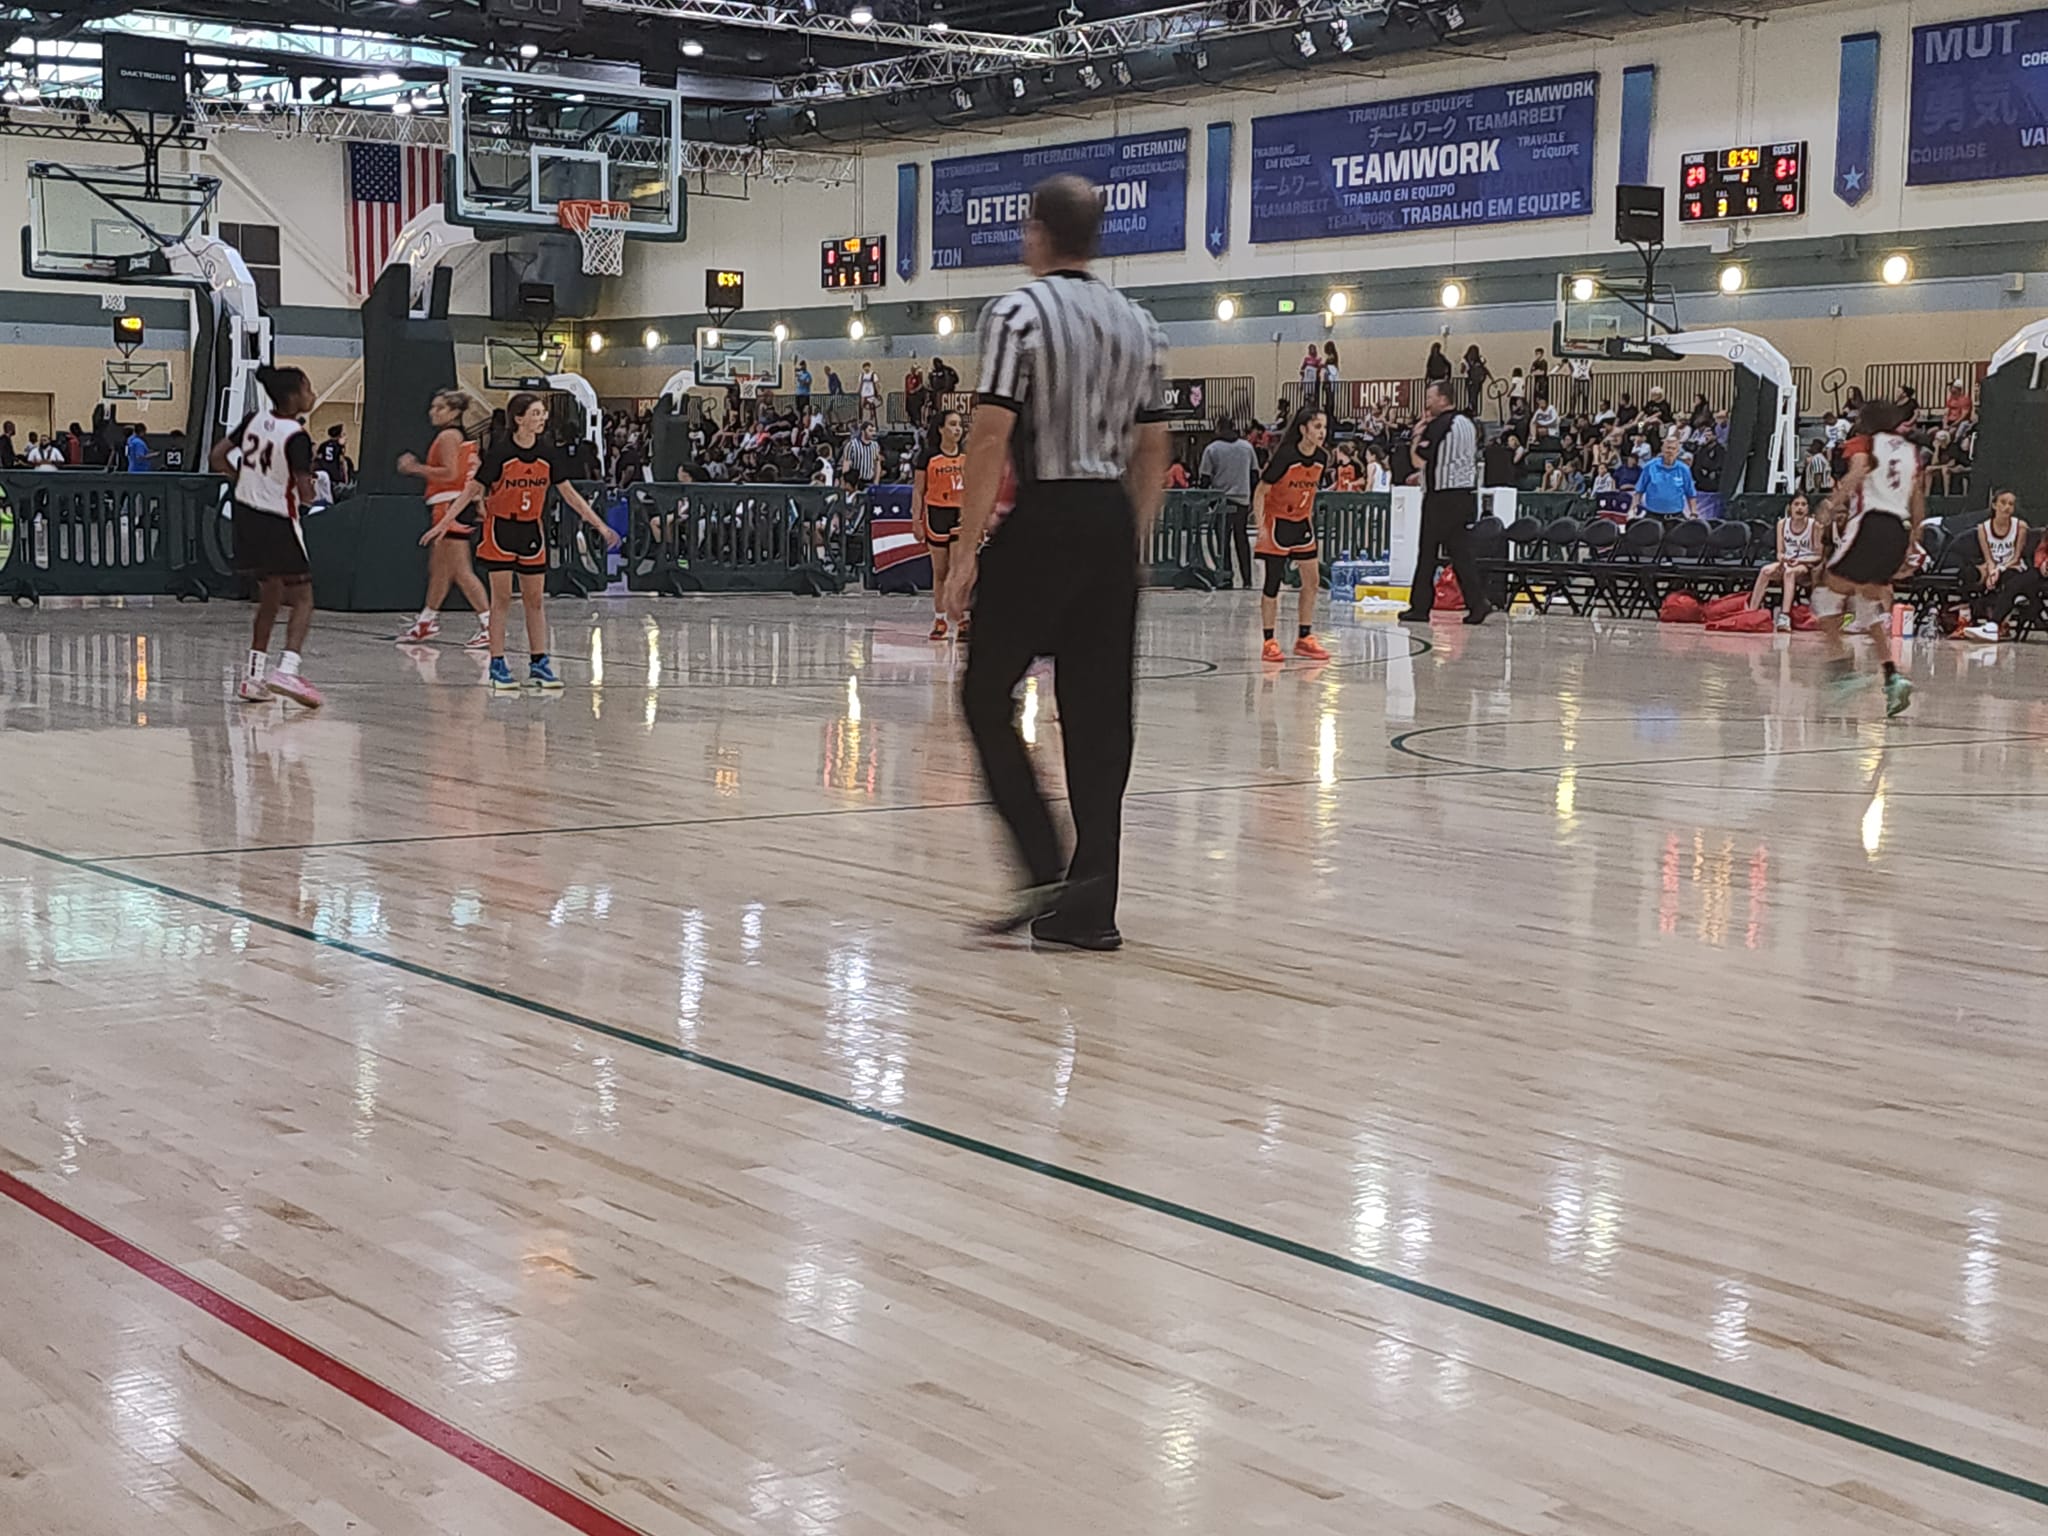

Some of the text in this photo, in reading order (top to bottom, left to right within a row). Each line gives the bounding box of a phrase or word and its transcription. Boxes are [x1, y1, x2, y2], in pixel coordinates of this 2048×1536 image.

[1925, 19, 2021, 65] MUT
[1505, 79, 1595, 108] TEAMWORK
[1348, 101, 1409, 127] TRAVAILE
[1466, 104, 1566, 132] TEAMARBEIT
[1369, 115, 1457, 148] チームワーク
[2020, 127, 2048, 148] VA
[1331, 138, 1501, 188] TEAMWORK
[1911, 142, 1988, 165] COURAGE
[966, 180, 1147, 226] DETERTION
[1343, 182, 1456, 207] TRABAJO EN EQUIPO
[1401, 190, 1582, 225] TRABALHO EM EQUIPE
[942, 392, 973, 415] GUEST
[1360, 381, 1400, 408] HOME
[167, 451, 181, 465] 23
[243, 433, 274, 476] 24
[325, 446, 334, 461] 5
[950, 474, 964, 490] 12
[521, 491, 531, 512] 5
